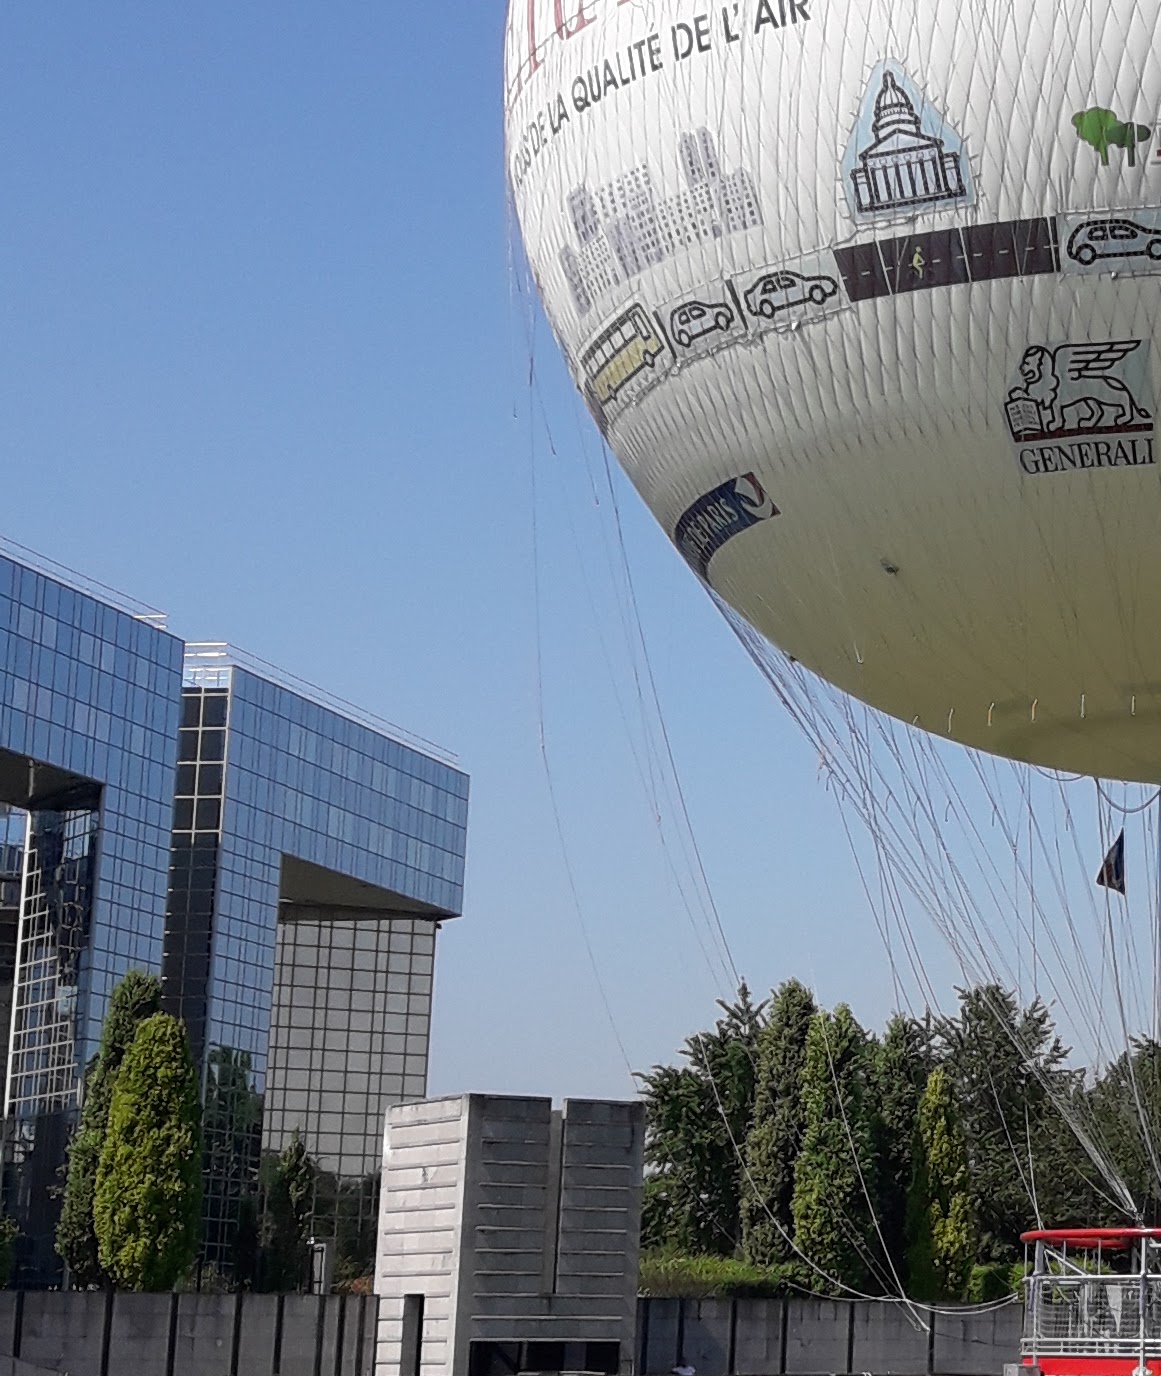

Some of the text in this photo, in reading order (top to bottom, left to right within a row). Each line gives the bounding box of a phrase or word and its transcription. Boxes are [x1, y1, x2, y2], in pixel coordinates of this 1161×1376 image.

[528, 111, 548, 158] DE
[547, 92, 570, 135] LA
[571, 22, 664, 113] QUALITÉ
[671, 13, 712, 61] DE
[1019, 437, 1157, 474] GENERALI
